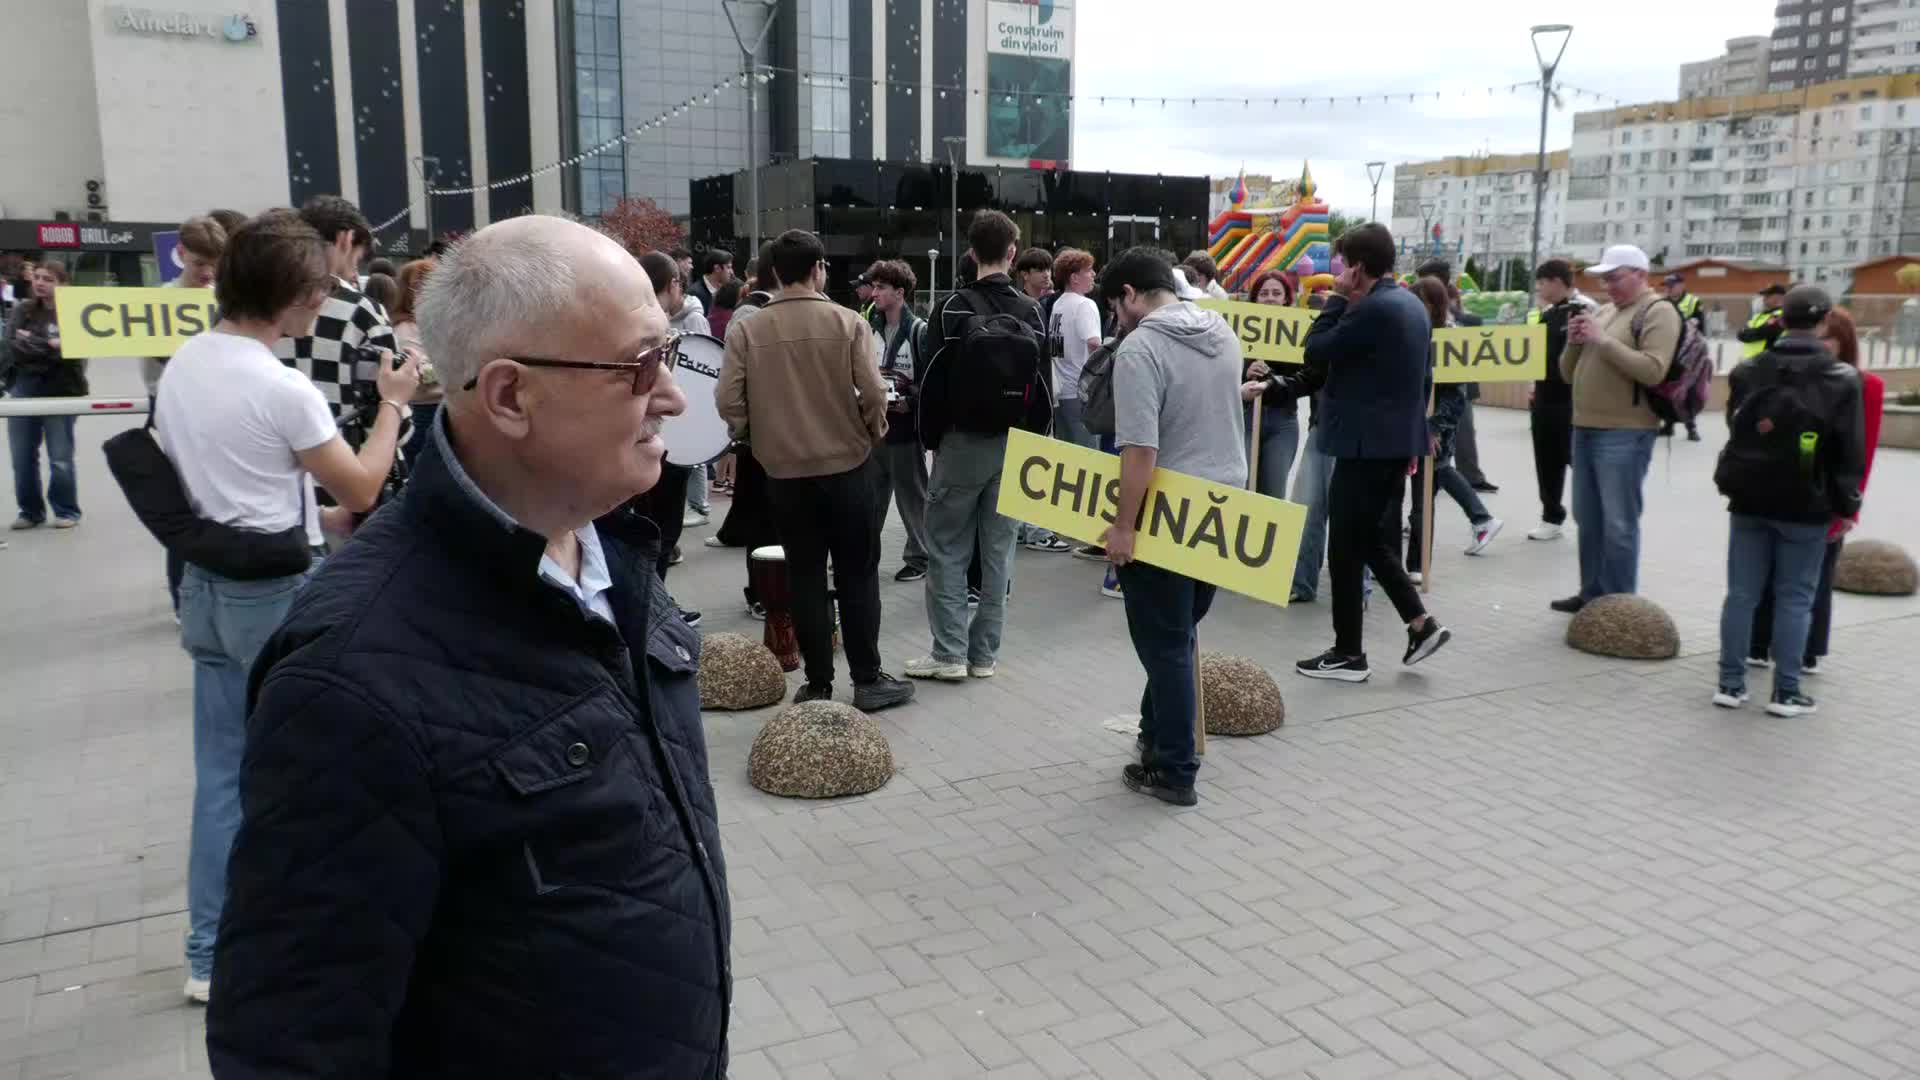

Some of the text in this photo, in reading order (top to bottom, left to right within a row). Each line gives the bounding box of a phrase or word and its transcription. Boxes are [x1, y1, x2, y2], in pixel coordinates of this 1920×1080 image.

[998, 22, 1064, 39] Construim
[1001, 36, 1058, 53] din valori
